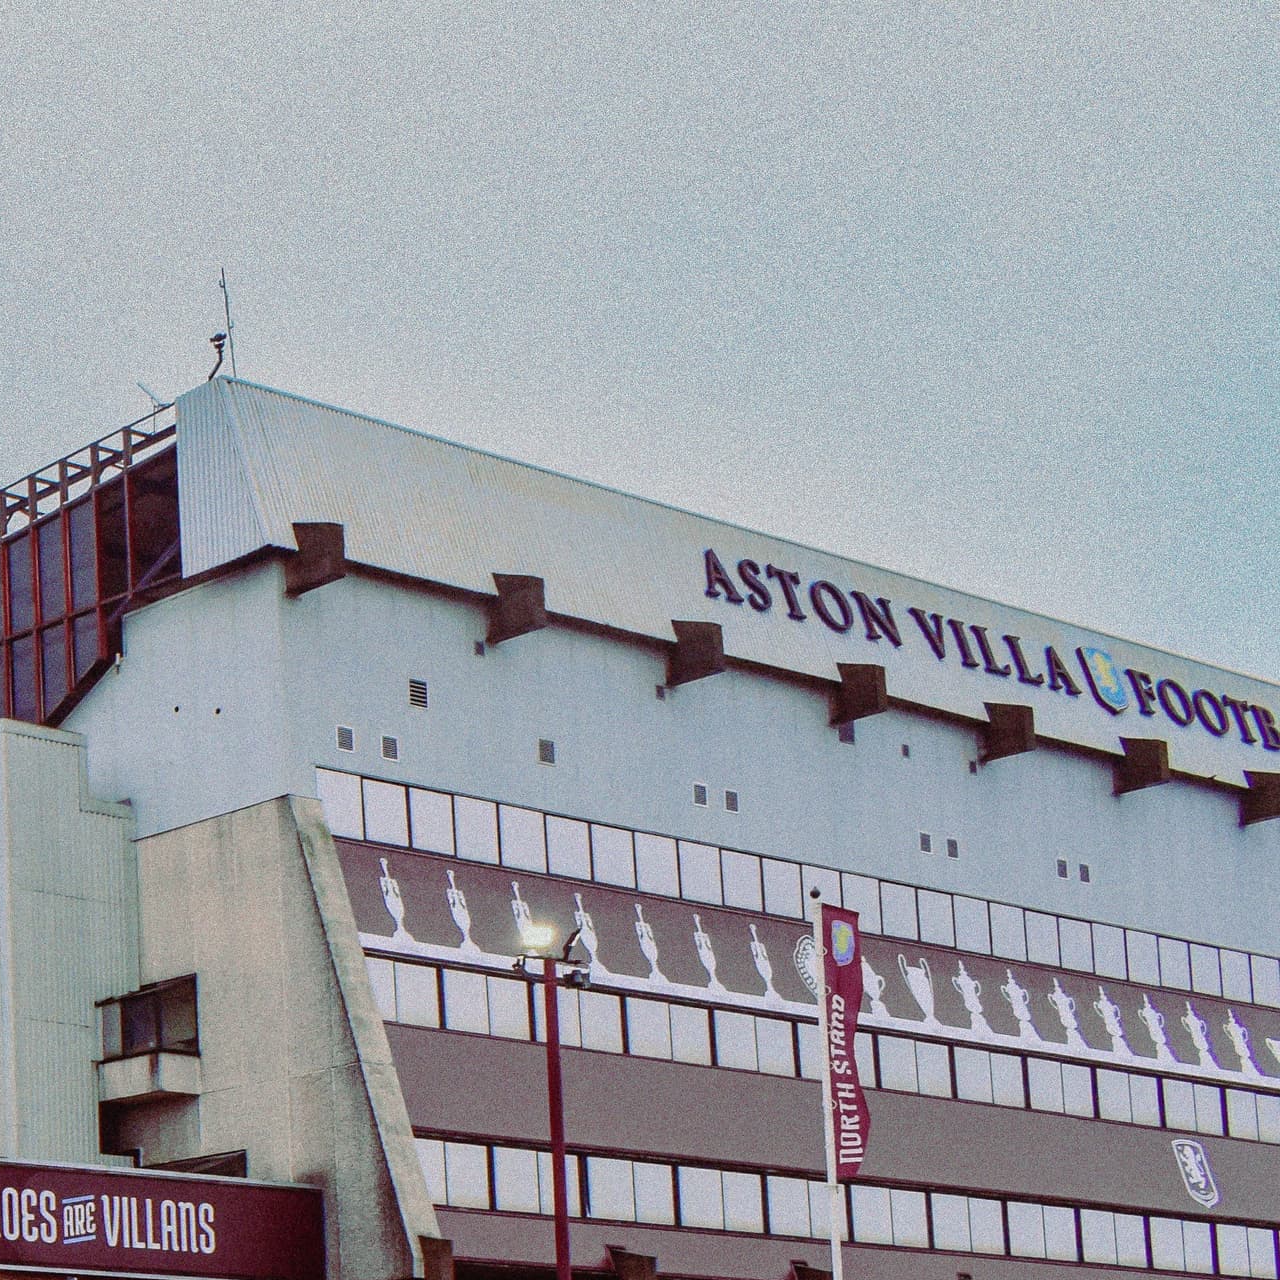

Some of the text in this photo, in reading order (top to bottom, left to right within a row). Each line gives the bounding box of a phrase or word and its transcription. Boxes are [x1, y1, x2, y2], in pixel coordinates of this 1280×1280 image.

[703, 547, 903, 648] ASTON
[907, 605, 1083, 697] VILLA
[830, 993, 864, 1165] NORTH STAND
[63, 1200, 97, 1240] ARE
[100, 1194, 217, 1255] VILLANS
